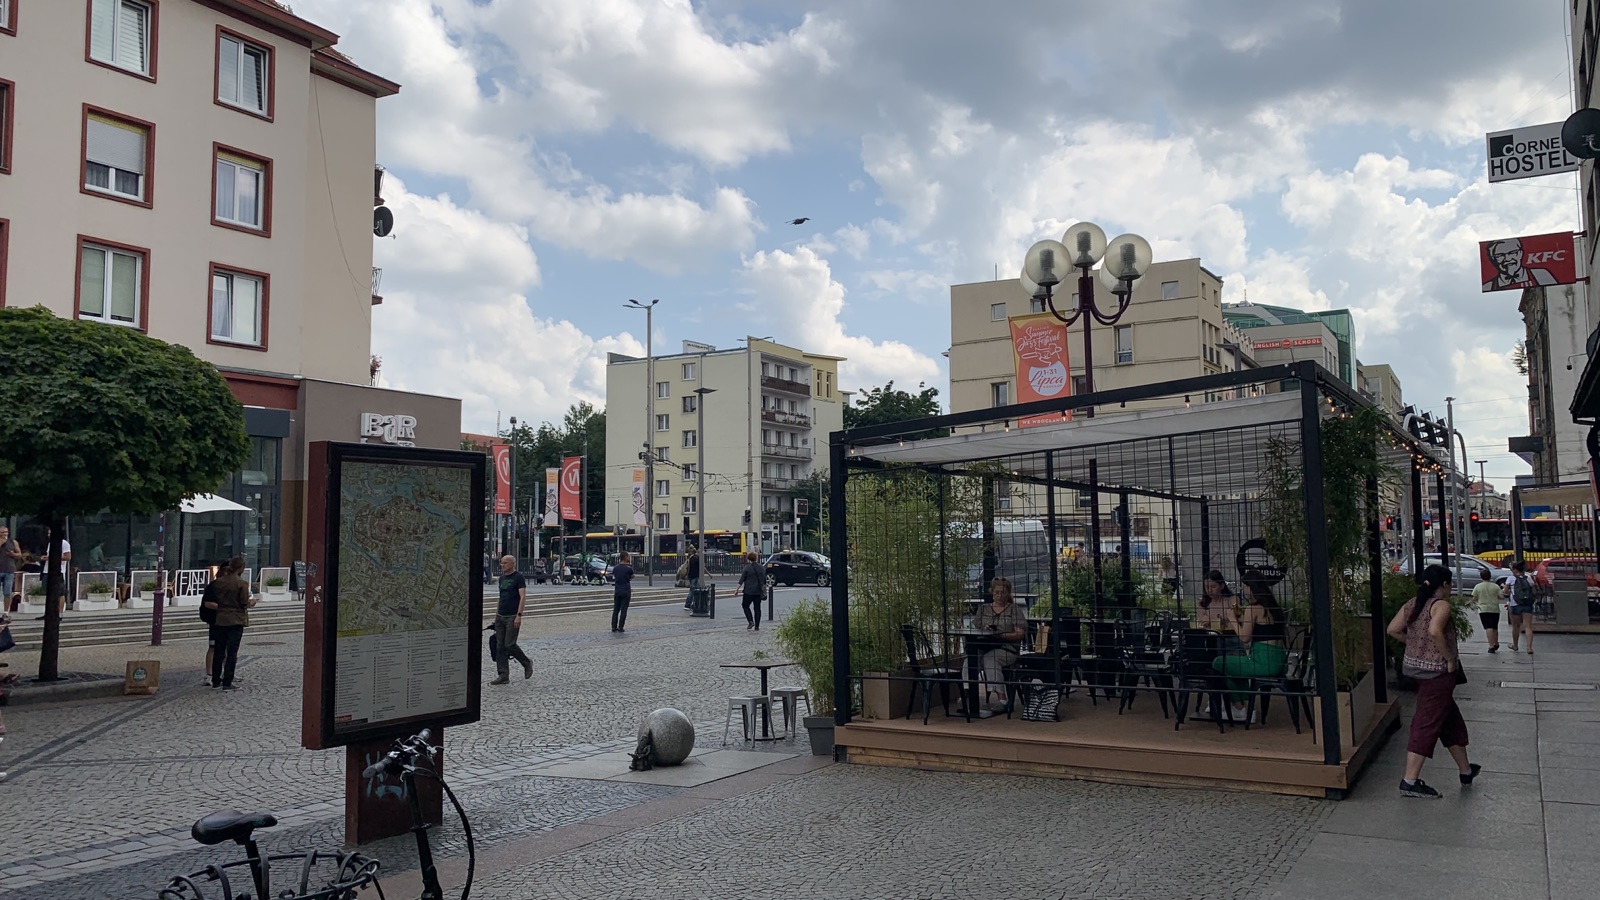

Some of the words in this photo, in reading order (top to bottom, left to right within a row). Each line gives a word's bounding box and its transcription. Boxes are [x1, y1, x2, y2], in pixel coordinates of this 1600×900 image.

[1502, 137, 1561, 156] CORNE
[1490, 149, 1576, 177] HOSTEL
[1526, 249, 1566, 265] KFC
[1024, 326, 1054, 341] Summer
[1294, 338, 1320, 346] SCHOOL
